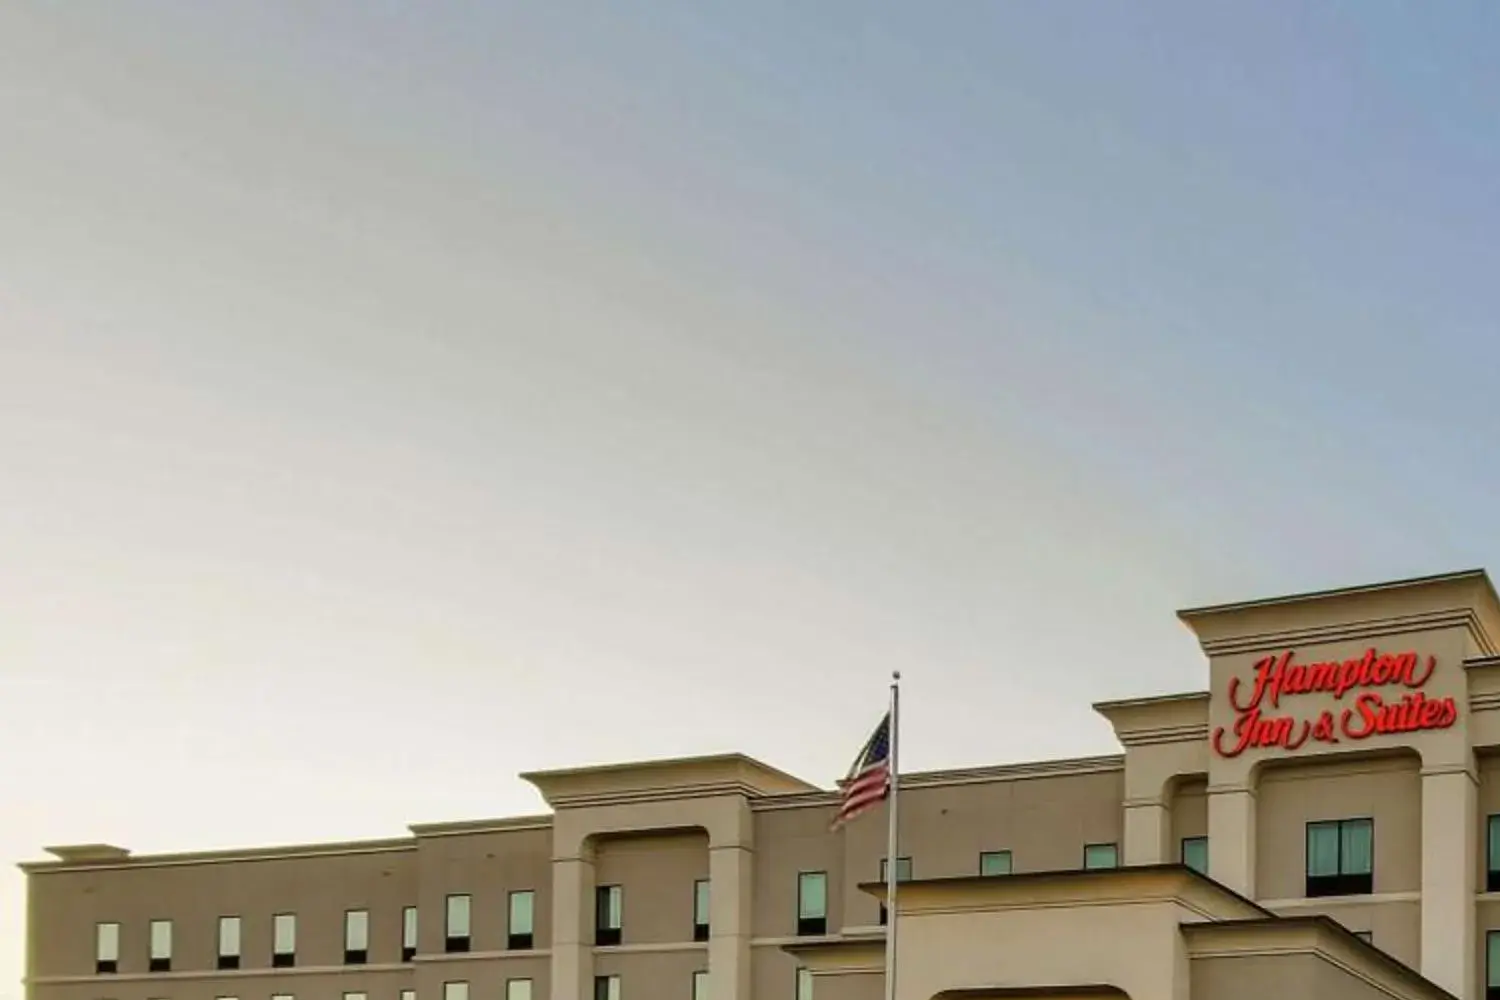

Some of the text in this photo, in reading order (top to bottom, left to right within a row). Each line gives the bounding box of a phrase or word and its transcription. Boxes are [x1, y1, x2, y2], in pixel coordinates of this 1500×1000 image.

[1229, 648, 1437, 711] Hampton
[1213, 691, 1457, 758] Inn & Suites
